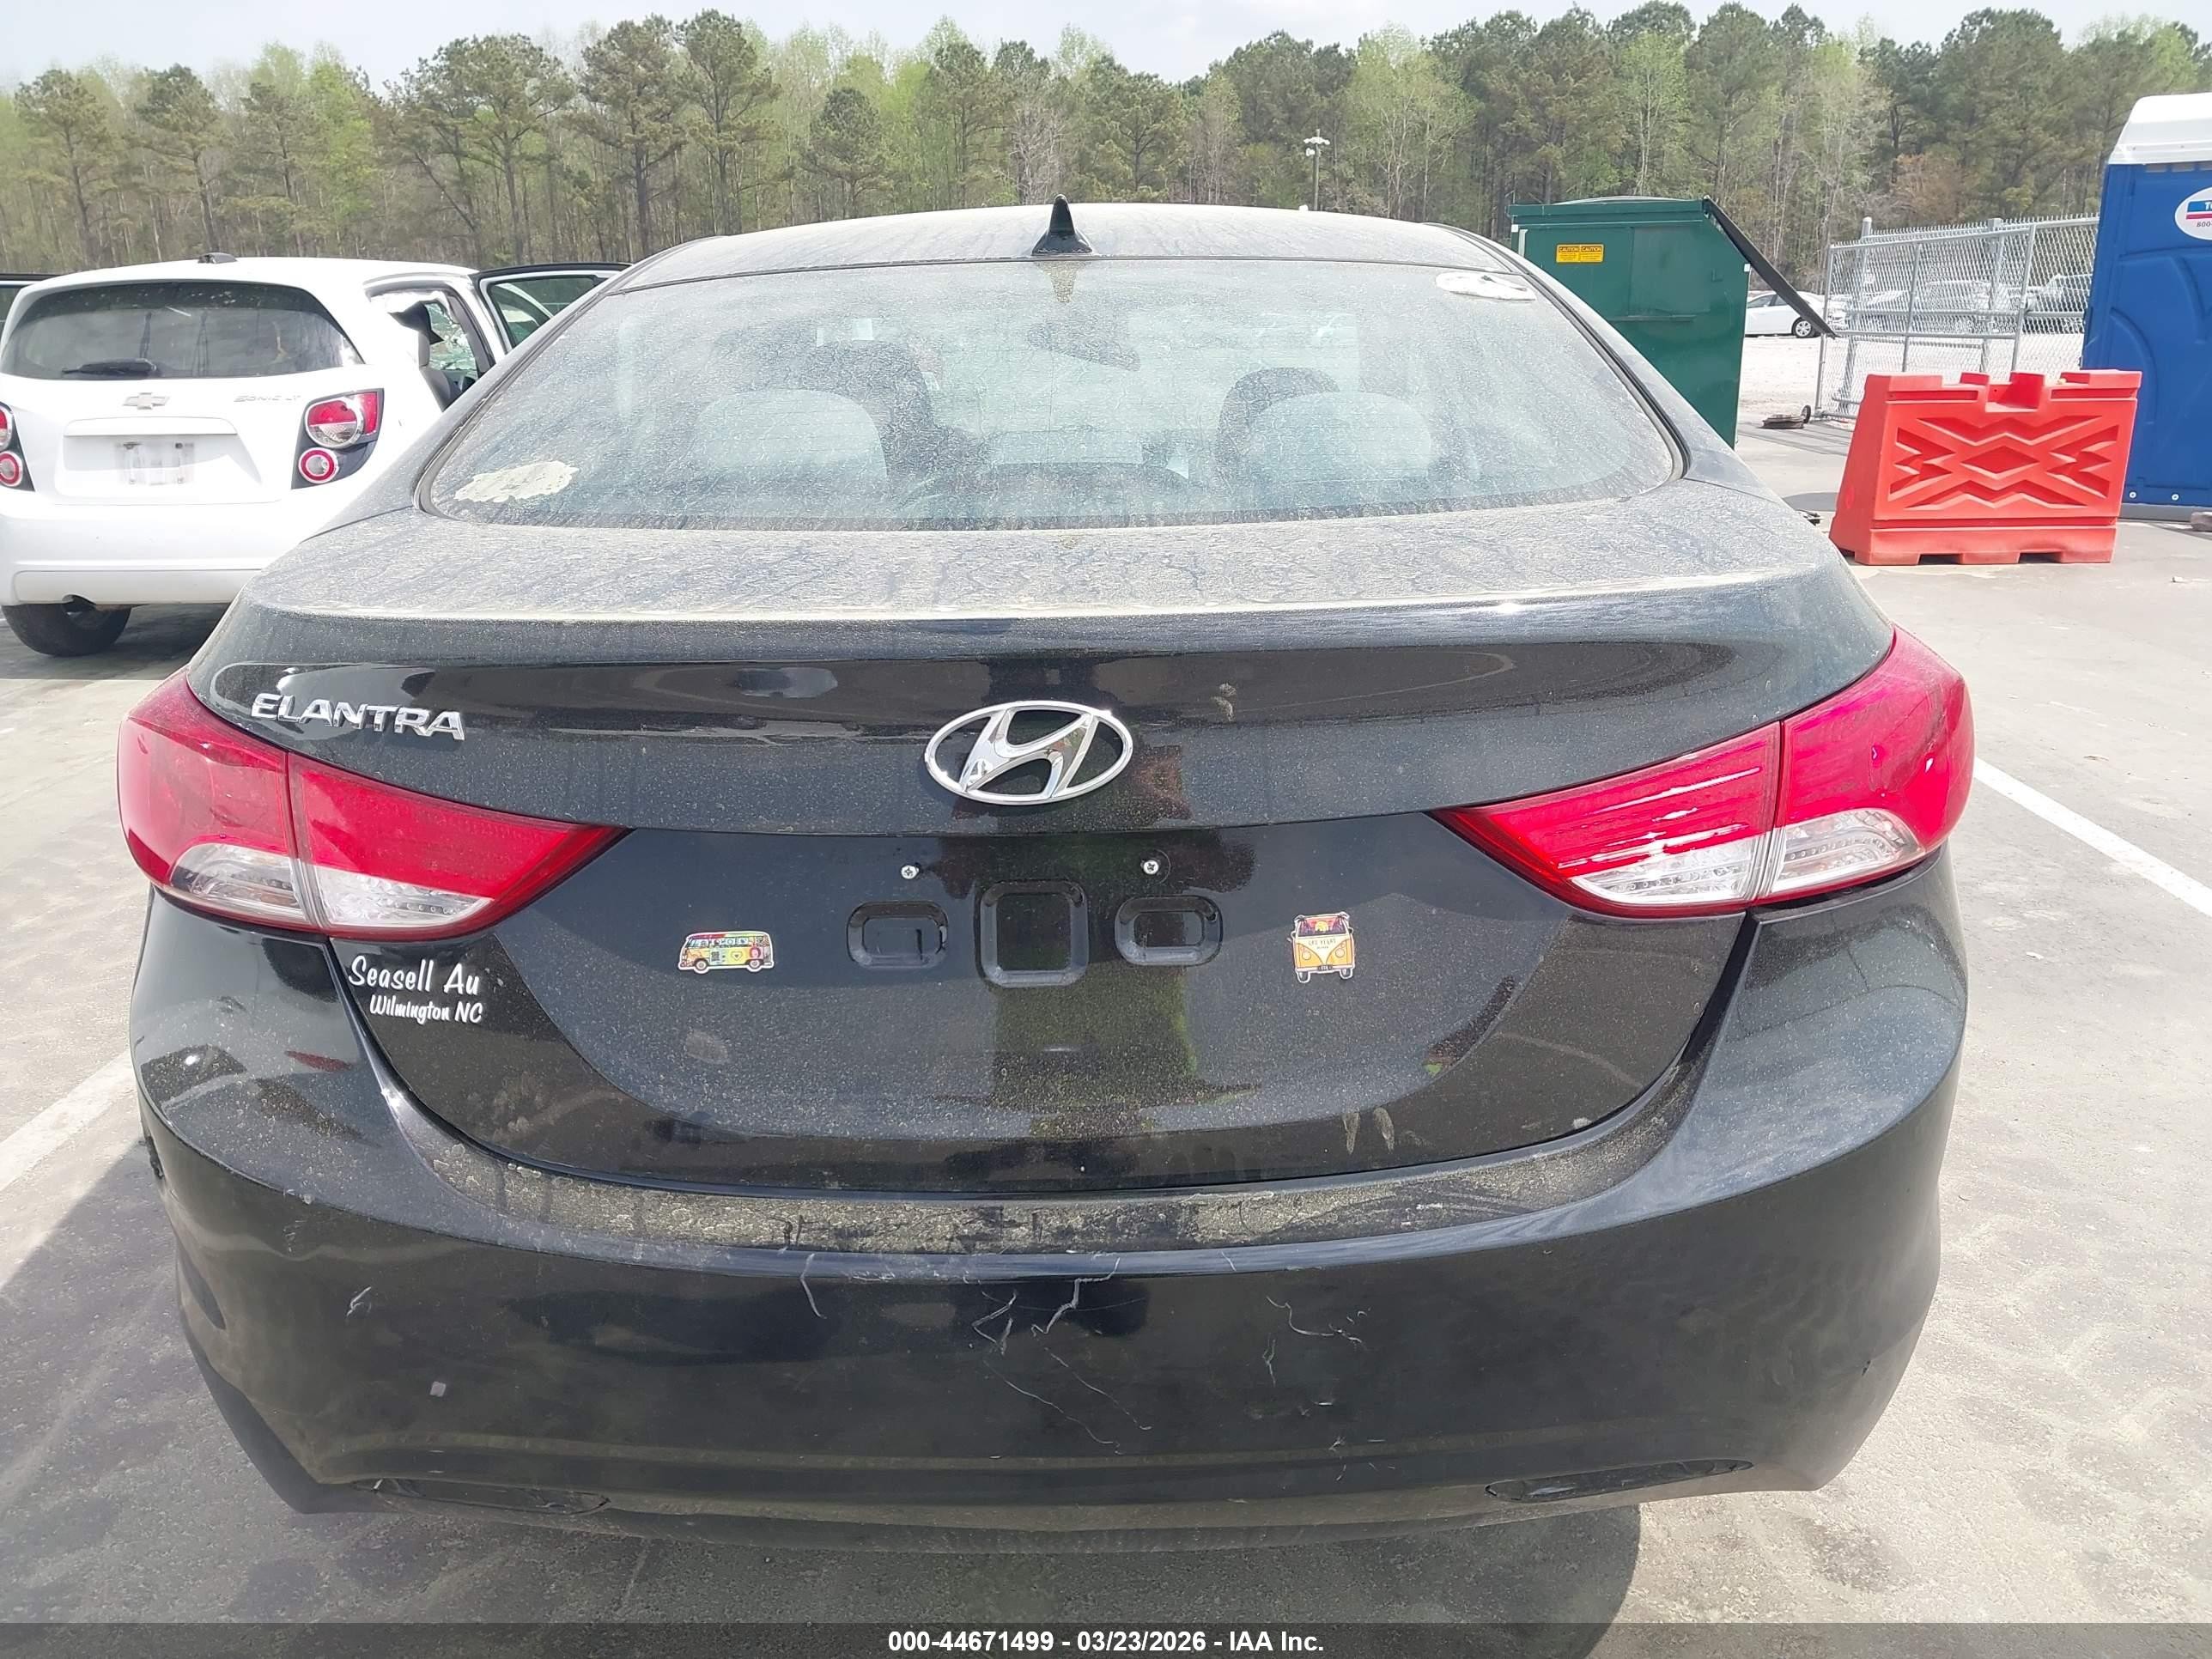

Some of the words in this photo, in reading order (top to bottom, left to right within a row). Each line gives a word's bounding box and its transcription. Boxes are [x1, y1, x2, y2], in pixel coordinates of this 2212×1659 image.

[251, 692, 465, 741] ELANTRA
[348, 955, 434, 992] Seasell
[443, 963, 480, 995] Au
[369, 994, 451, 1025] Wilmington
[454, 1000, 483, 1023] NC
